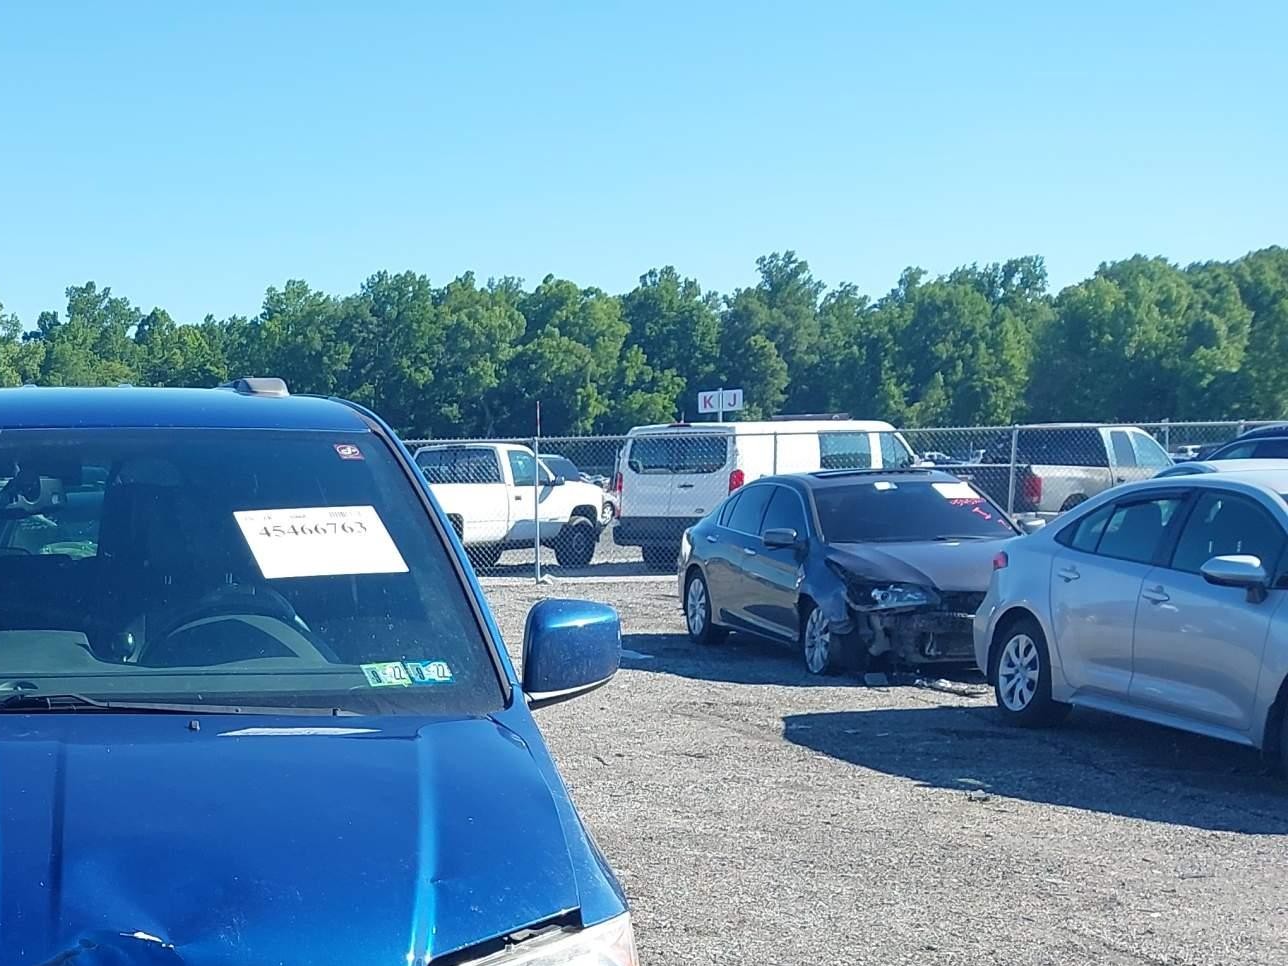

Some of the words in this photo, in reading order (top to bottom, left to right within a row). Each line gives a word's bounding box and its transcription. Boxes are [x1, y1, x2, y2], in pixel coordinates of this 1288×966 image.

[703, 395, 713, 409] K
[728, 393, 737, 407] J
[258, 521, 367, 538] 45466763
